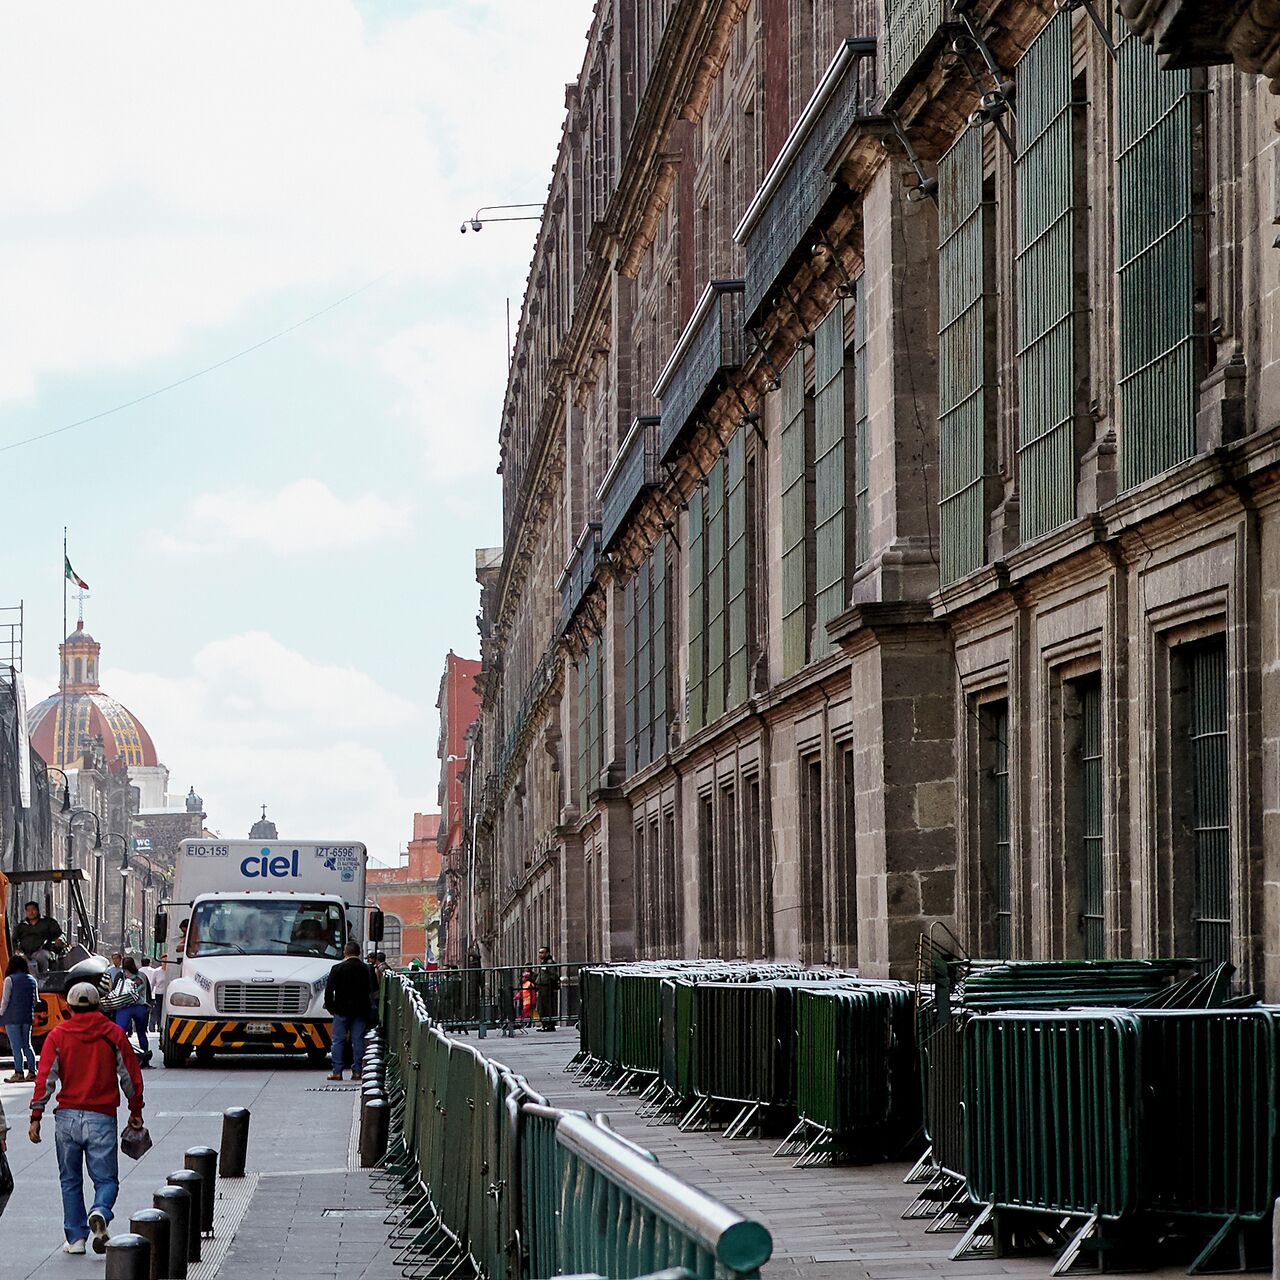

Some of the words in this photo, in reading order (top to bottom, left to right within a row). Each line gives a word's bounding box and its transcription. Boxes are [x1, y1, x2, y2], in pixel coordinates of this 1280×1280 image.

[188, 846, 227, 856] EIO-155
[316, 847, 353, 857] IZT-6596
[240, 847, 299, 878] ciel
